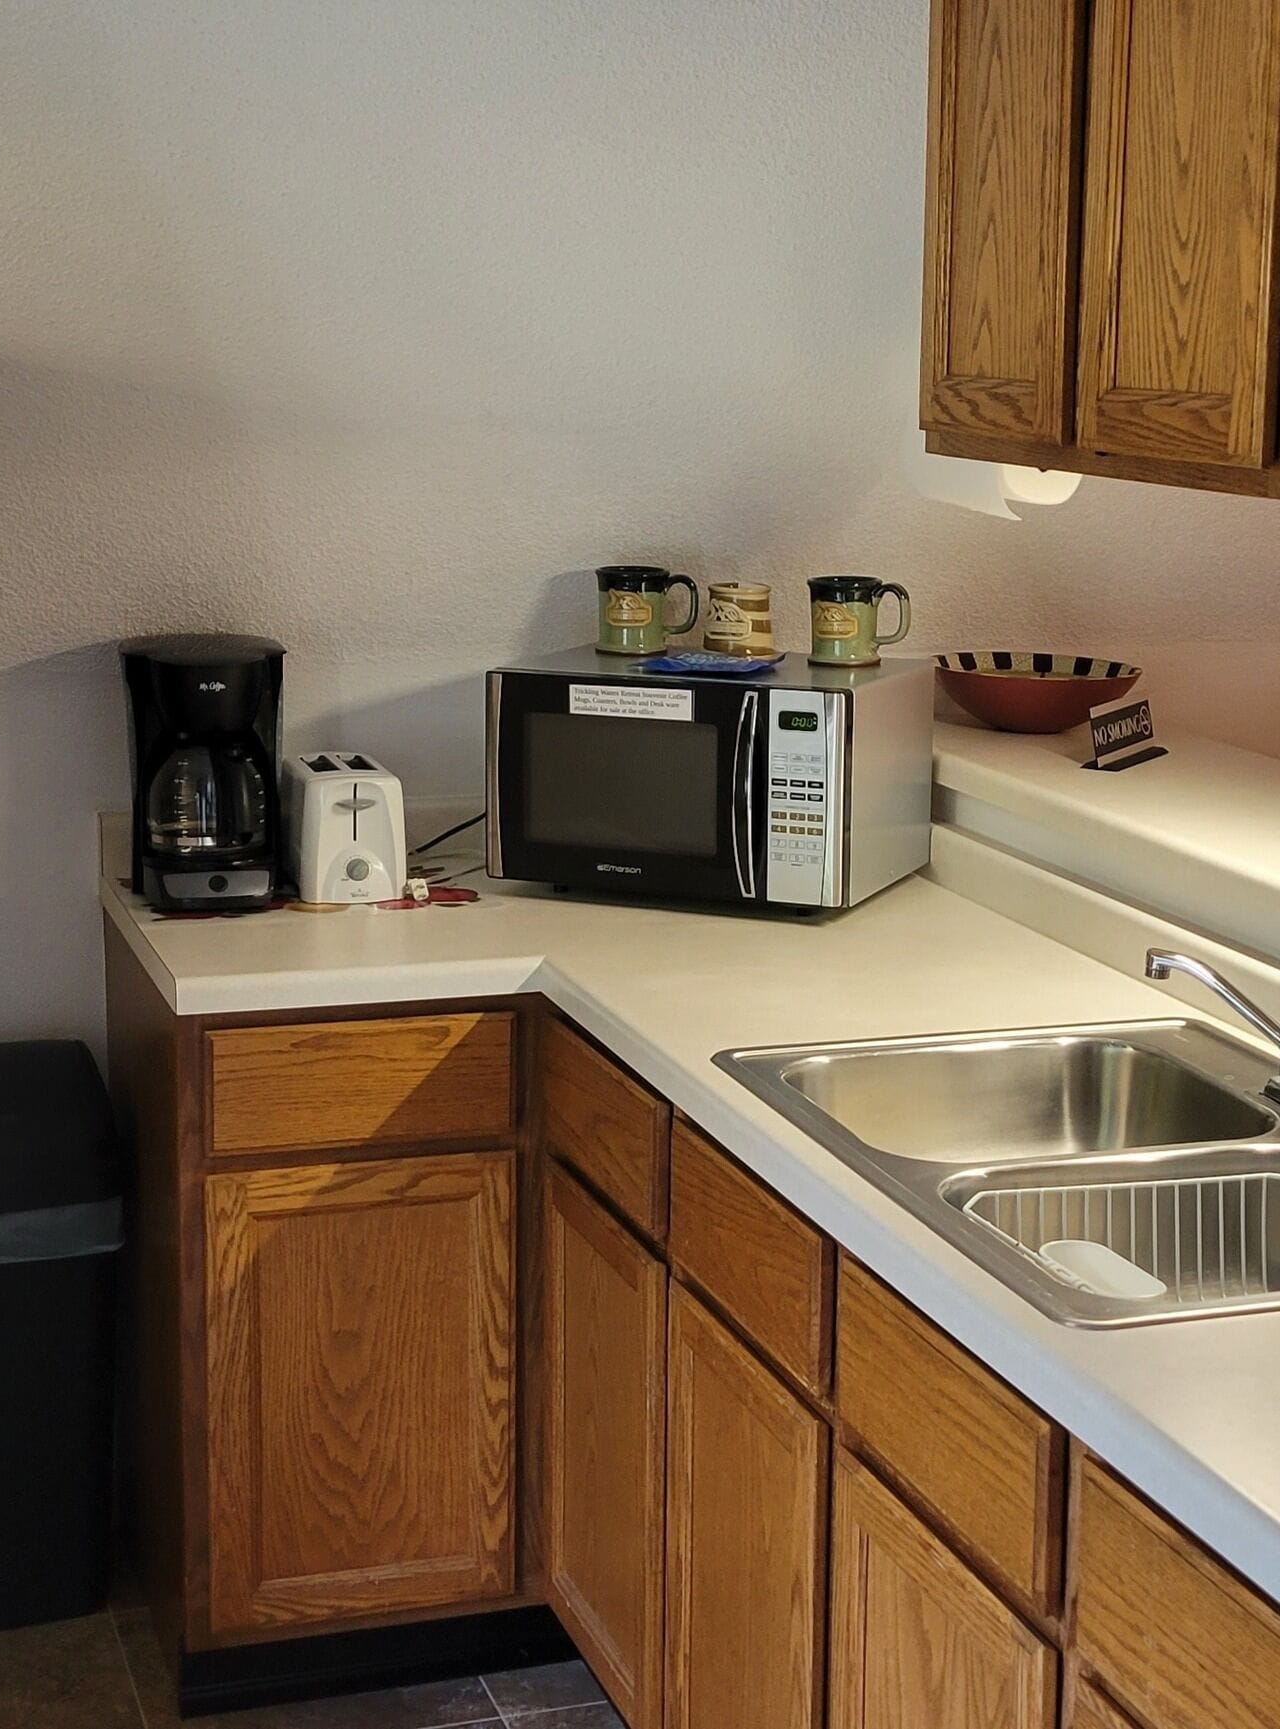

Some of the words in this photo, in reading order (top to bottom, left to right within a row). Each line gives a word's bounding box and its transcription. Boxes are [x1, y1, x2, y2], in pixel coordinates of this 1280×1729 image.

[1094, 726, 1108, 747] NO
[1107, 714, 1141, 743] SMOKING
[603, 864, 641, 874] Emerson
